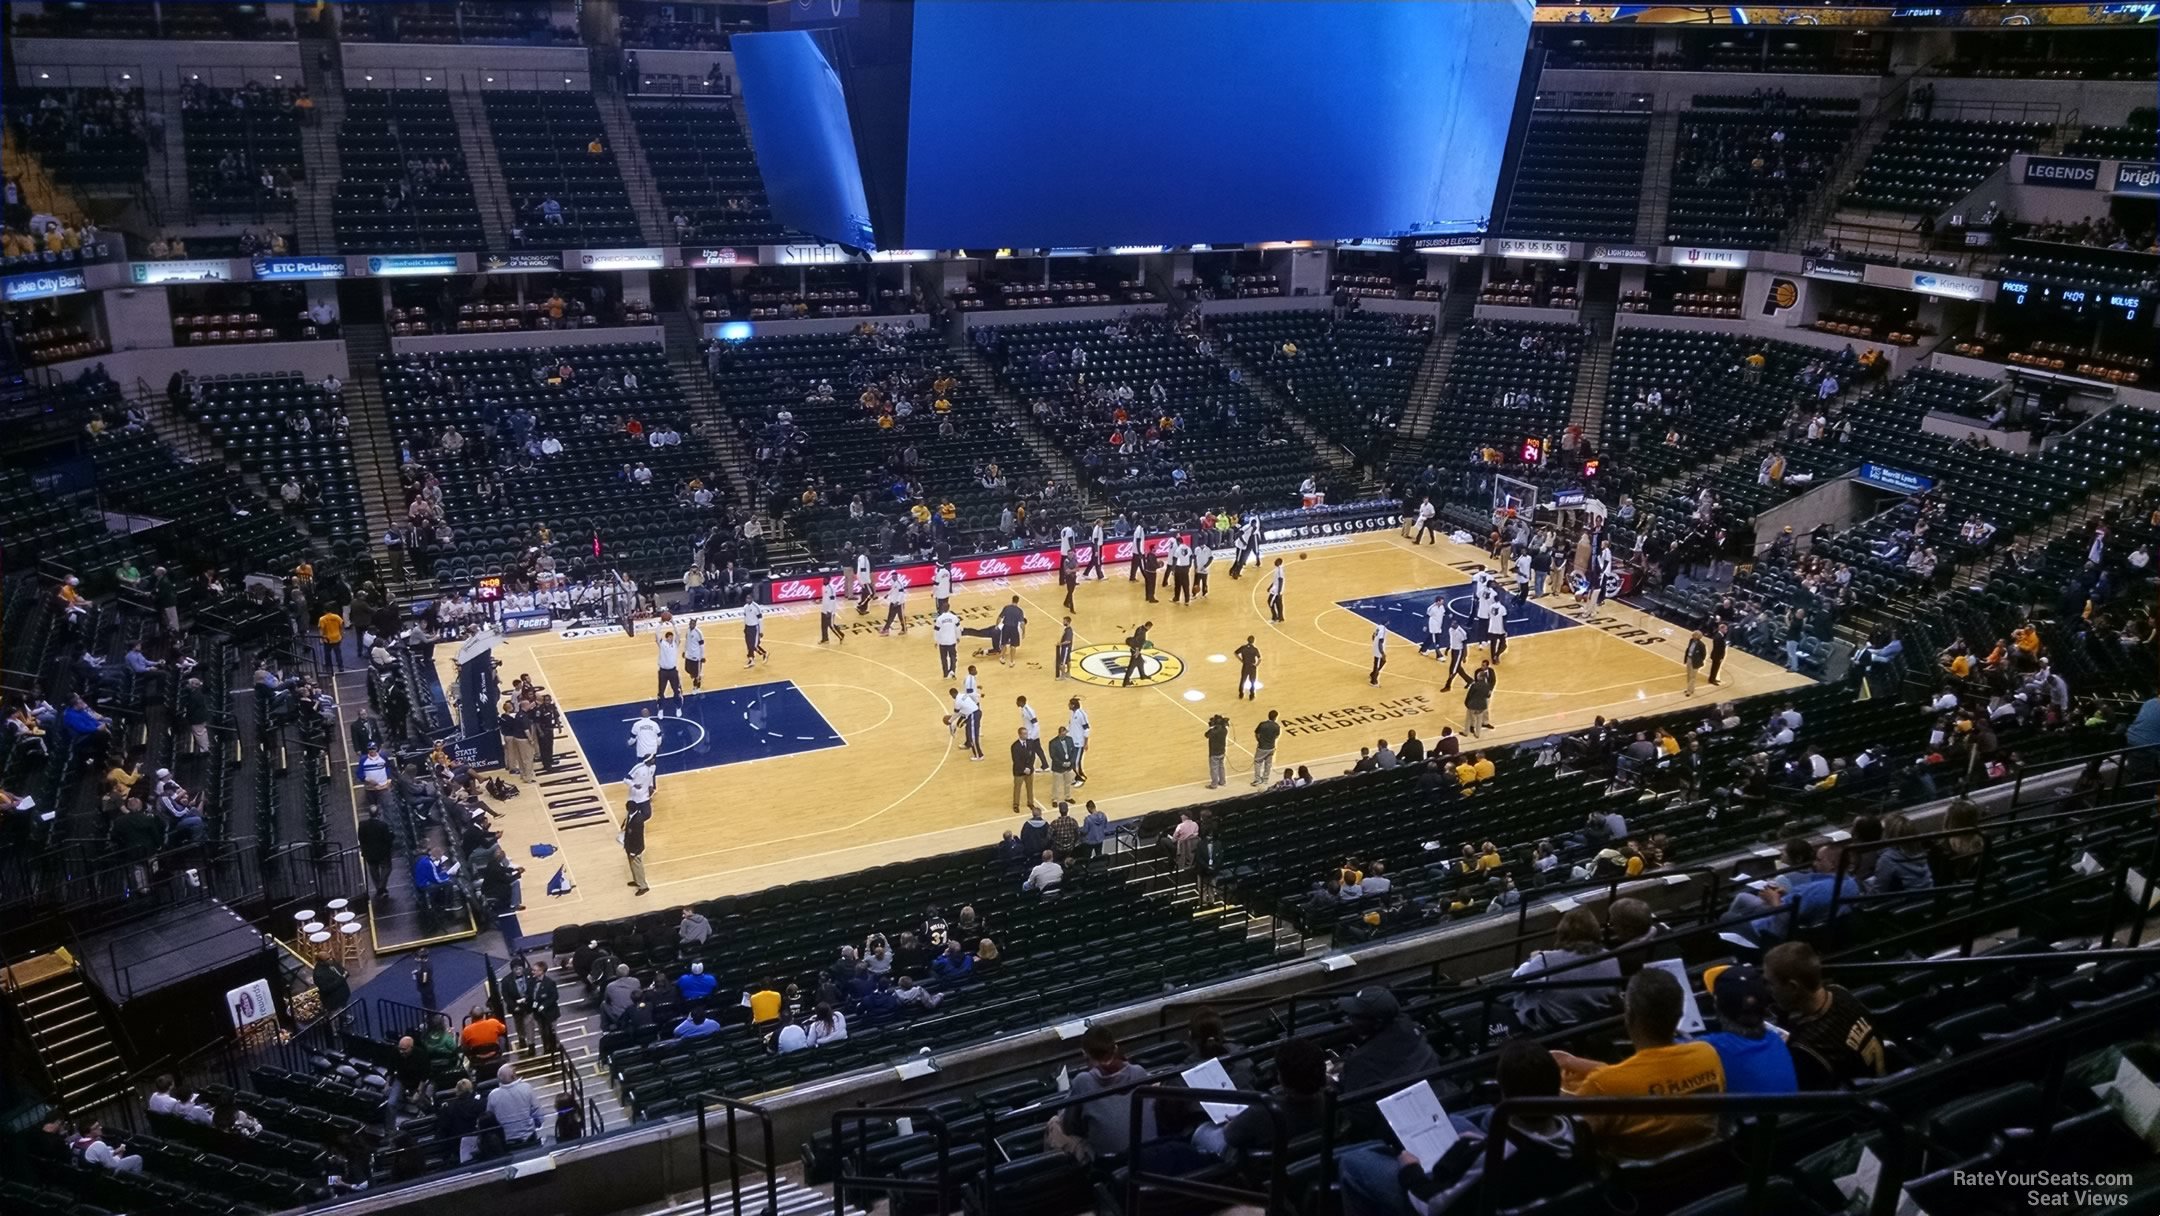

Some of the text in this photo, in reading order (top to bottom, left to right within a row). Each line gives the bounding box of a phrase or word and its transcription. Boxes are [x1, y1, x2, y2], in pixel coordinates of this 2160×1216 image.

[2028, 165, 2095, 181] LEGENDS
[1415, 236, 1480, 248] MITSUBISHI ELECTRIC
[702, 249, 719, 258] the
[1607, 249, 1647, 258] LIGHTBOUND
[1703, 252, 1733, 262] IUPUI
[706, 256, 723, 265] fan
[273, 263, 296, 273] ETC
[7, 274, 85, 294] Lake City Bank
[1939, 278, 1980, 294] Kinetico
[2002, 282, 2028, 293] PACERS
[2016, 295, 2024, 304] 0
[2063, 290, 2085, 302] 14:09
[2110, 295, 2139, 308] WOLVES
[2126, 310, 2135, 320] 0
[1524, 445, 1539, 460] 24
[1586, 467, 1596, 476] 24
[1882, 468, 1901, 479] Merrill
[1901, 474, 1918, 485] Lynch
[1311, 525, 1320, 534] G
[1333, 522, 1342, 531] G
[1344, 521, 1353, 530] G
[1355, 519, 1364, 529] G
[1366, 518, 1374, 528] G
[1376, 517, 1385, 526] G
[977, 557, 1011, 577] Lilly
[1021, 552, 1055, 570] Lilly
[483, 587, 497, 598] 24
[778, 580, 817, 599] Lilly
[517, 616, 549, 628] Pacers
[1380, 694, 1431, 710] LIFE
[1285, 703, 1435, 737] FIELDHOUSE
[455, 747, 478, 757] STATE
[931, 930, 948, 945] 31
[253, 984, 268, 1016] rewards
[1668, 1068, 1718, 1094] PLAYOFFS
